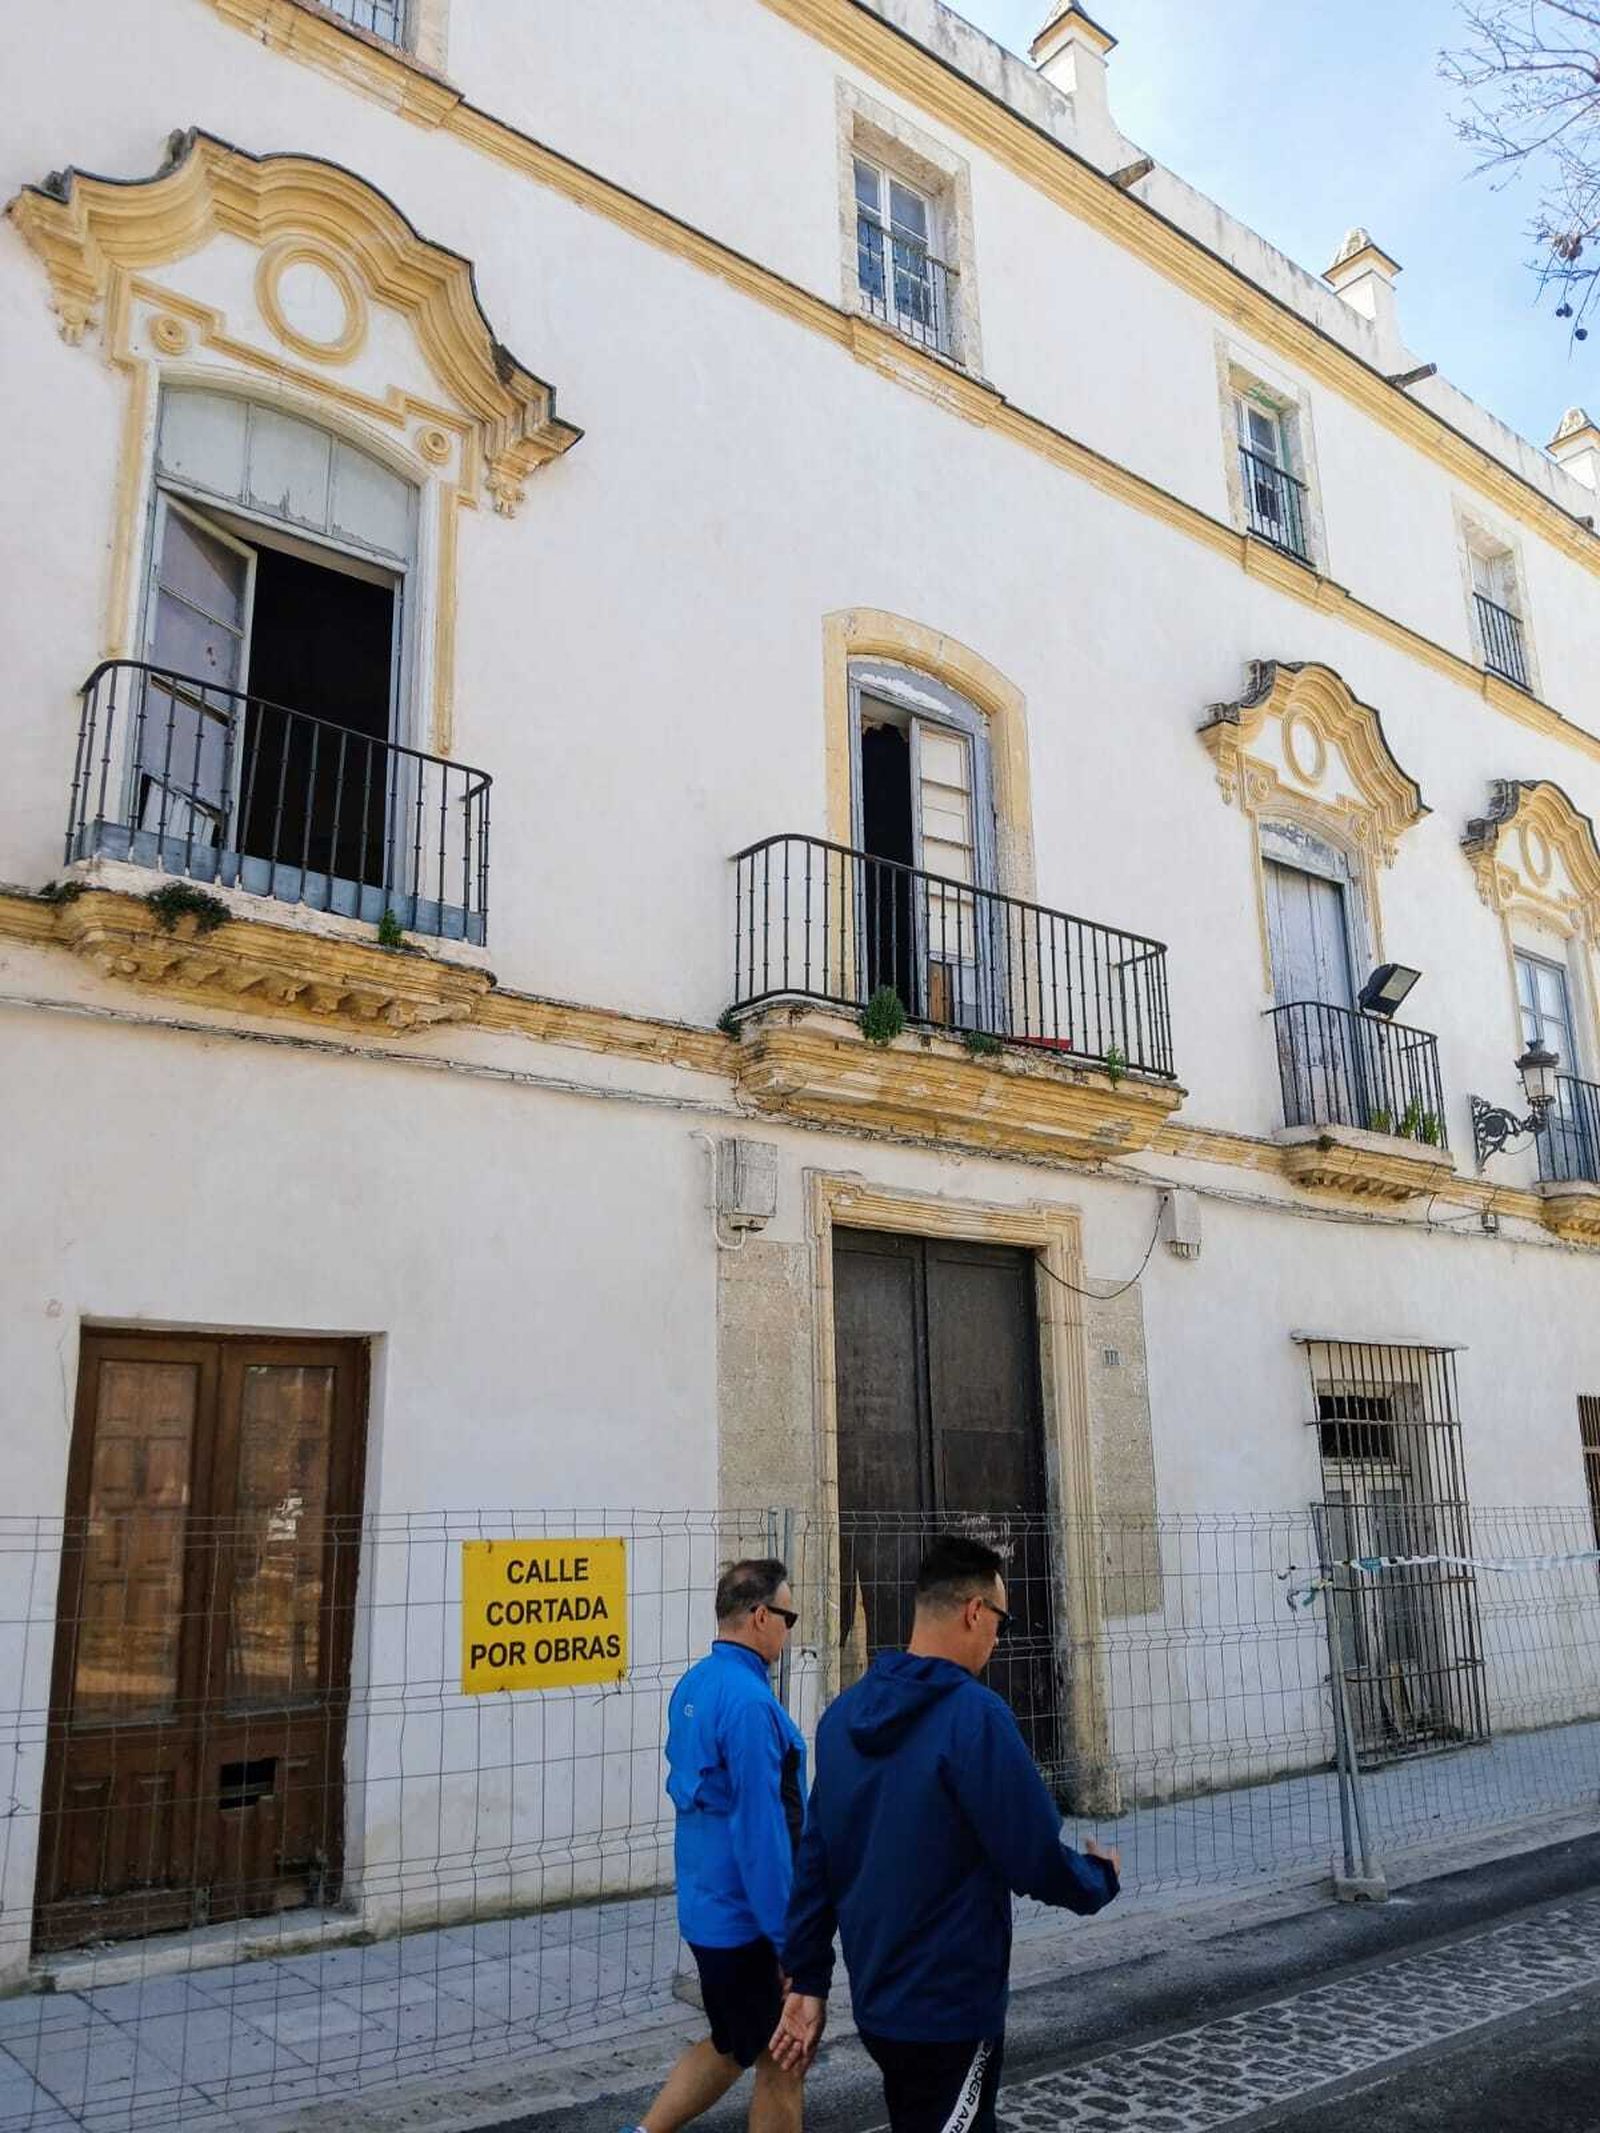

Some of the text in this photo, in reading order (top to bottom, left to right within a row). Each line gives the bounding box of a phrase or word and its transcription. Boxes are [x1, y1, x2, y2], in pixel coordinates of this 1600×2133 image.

[507, 1558, 589, 1584] CALLE
[486, 1596, 608, 1626] CORTADA
[471, 1634, 621, 1670] POR OBRAS
